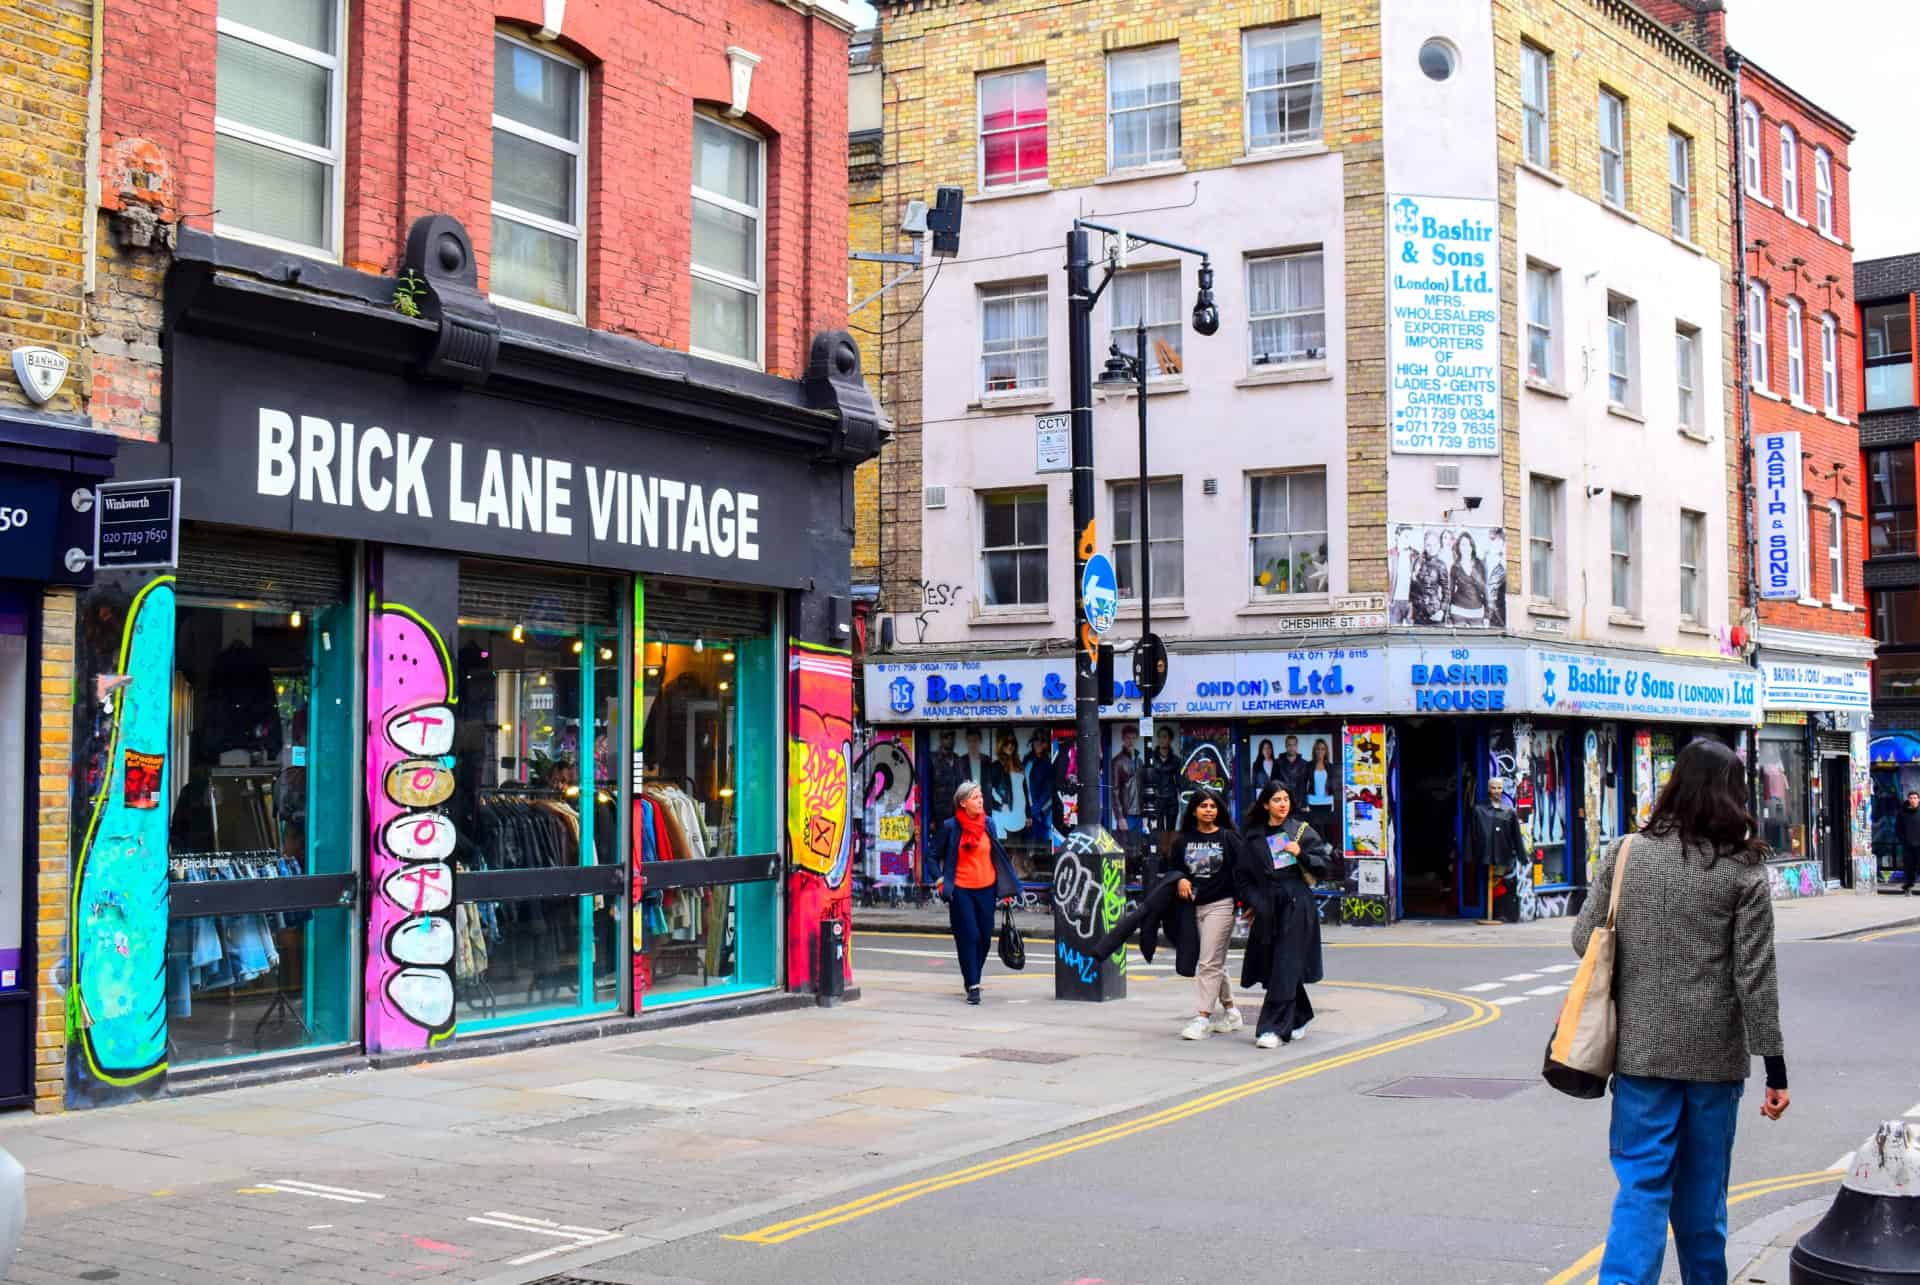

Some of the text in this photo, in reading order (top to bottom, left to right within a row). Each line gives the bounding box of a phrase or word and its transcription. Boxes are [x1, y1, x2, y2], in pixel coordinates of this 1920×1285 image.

[1422, 216, 1492, 241] Bashir
[1402, 240, 1484, 267] & Sons
[1394, 270, 1493, 293] (London) Ltd.
[1424, 294, 1466, 307] MFRS.
[1395, 306, 1495, 322] WHOLESALERS
[1404, 321, 1485, 336] EXPORTERS
[1405, 335, 1483, 350] IMPORTERS
[28, 354, 66, 369] BANHAM
[1434, 351, 1453, 363] OF
[1397, 363, 1493, 378] HIGH QUALITY
[1408, 392, 1483, 407] GARMENTS
[1405, 406, 1495, 421] 071 739 0834
[1037, 418, 1068, 430] CCTV
[1406, 421, 1496, 435] 071 729 7635
[1411, 435, 1433, 447] 071
[1438, 436, 1462, 448] 739
[1467, 437, 1496, 449] 8115
[257, 407, 760, 561] BRICK LANE VINTAGE
[1767, 437, 1786, 516] BASHIR
[105, 496, 150, 511] Winkworth
[103, 528, 168, 545] 020 7749 7650
[1770, 535, 1789, 588] SONS
[1281, 618, 1336, 629] CHESHIRE
[1288, 651, 1304, 660] FAX
[1452, 650, 1469, 659] 180
[1412, 665, 1508, 685] BASHIR
[926, 674, 1023, 704] Bashir
[1042, 672, 1067, 700] &
[1288, 665, 1354, 696] Ltd.
[1568, 665, 1620, 695] Bashir
[1625, 670, 1638, 696] &
[1641, 672, 1674, 699] Sons
[1733, 681, 1754, 704] Ltd
[923, 705, 1008, 716] MANUFACTURERS
[1117, 703, 1132, 713] OF
[1186, 701, 1232, 712] QUALITY
[1242, 699, 1325, 711] LEATHERWEAR
[1416, 690, 1505, 711] HOUSE
